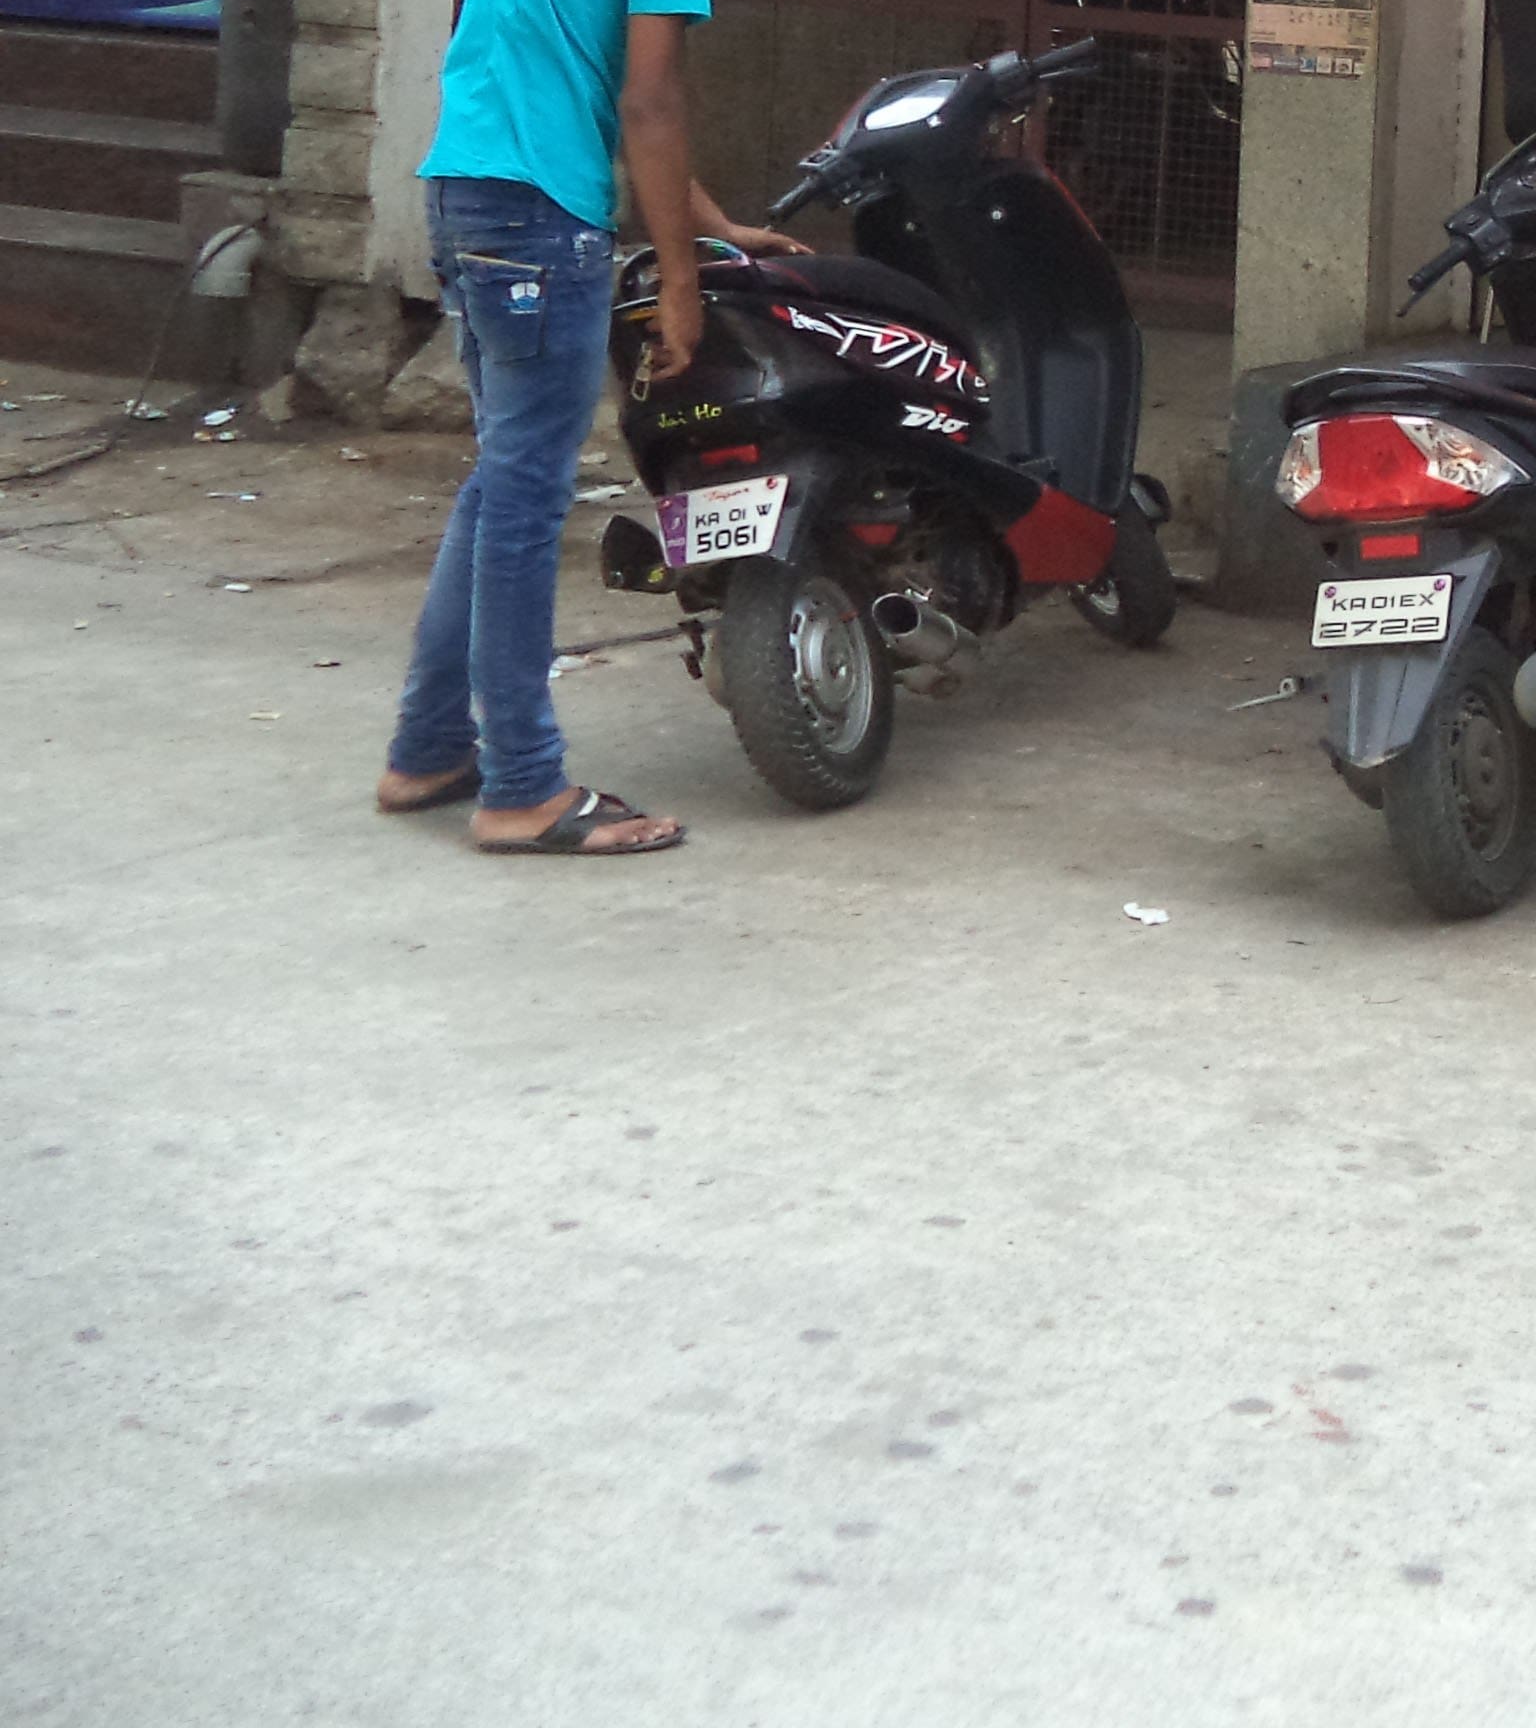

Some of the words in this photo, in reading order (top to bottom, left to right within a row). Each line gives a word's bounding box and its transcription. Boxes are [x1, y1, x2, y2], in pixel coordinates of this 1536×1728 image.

[694, 402, 722, 421] Ho
[901, 402, 970, 434] Dio
[695, 512, 720, 529] KA
[755, 502, 773, 517] W
[697, 525, 758, 555] 5061
[1319, 616, 1441, 639] 2722
